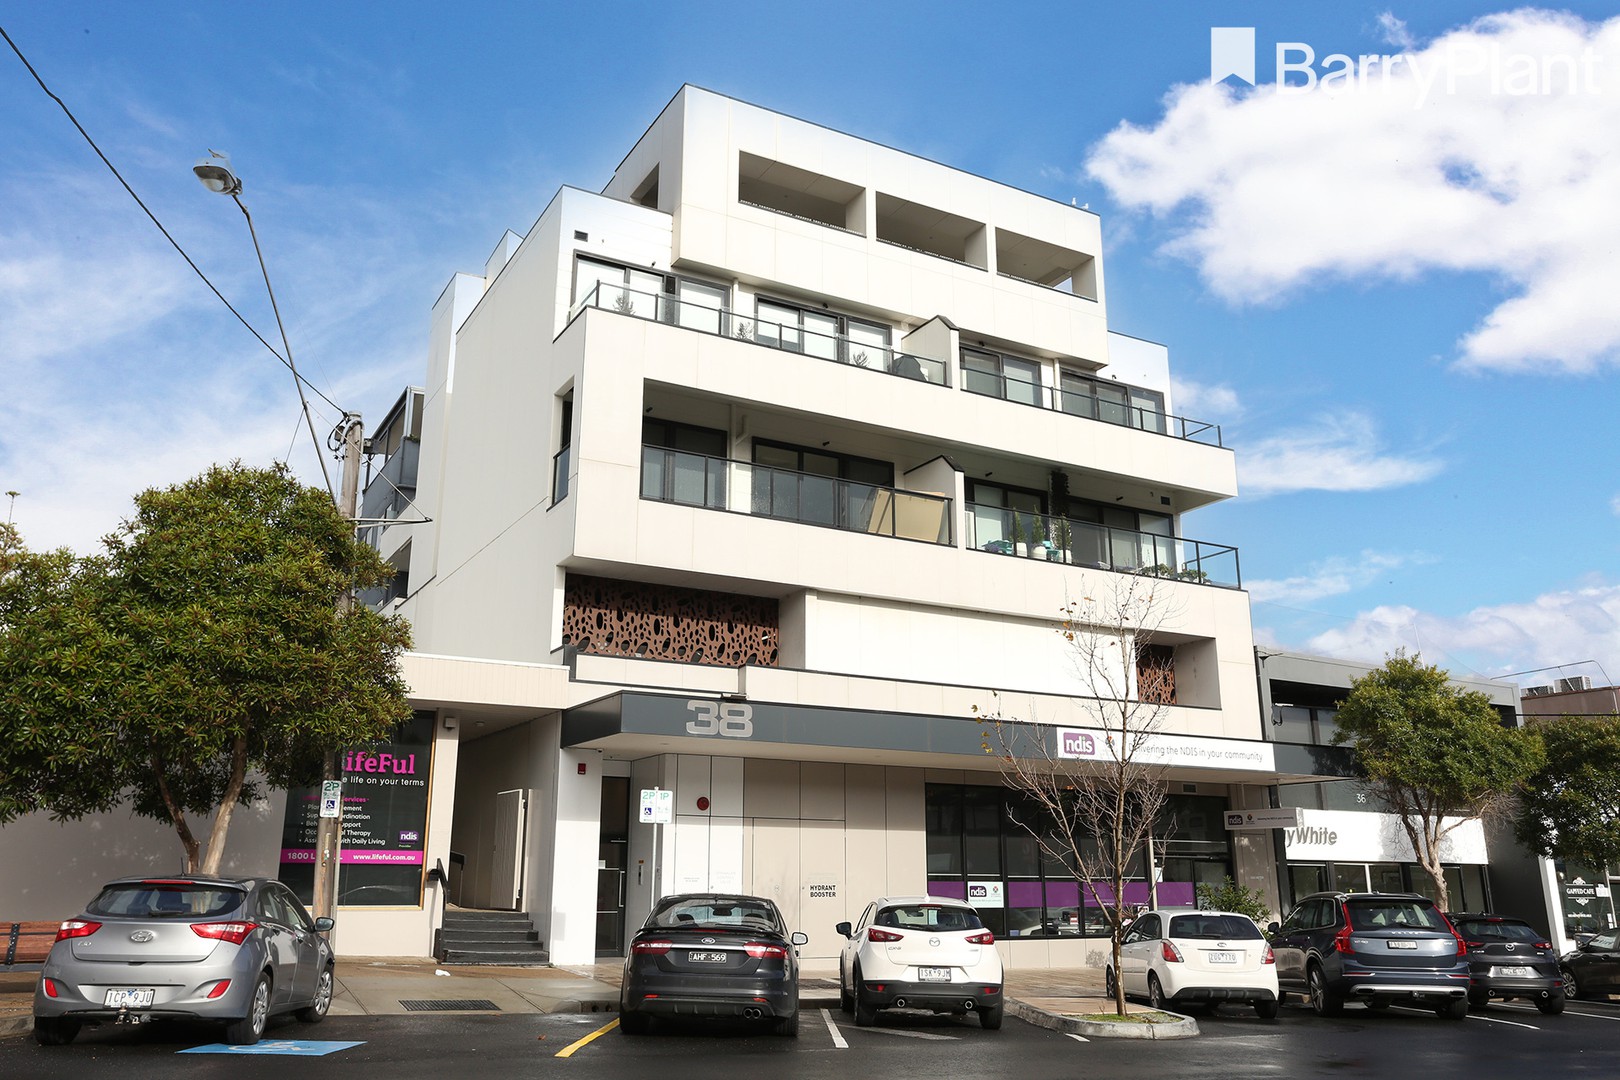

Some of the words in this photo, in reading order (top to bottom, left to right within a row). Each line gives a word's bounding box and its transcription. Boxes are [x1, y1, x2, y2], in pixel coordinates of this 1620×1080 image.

[686, 700, 753, 737] 38
[1066, 736, 1093, 752] ndis
[1129, 743, 1165, 756] Dlivering
[1167, 745, 1178, 755] the
[1180, 747, 1198, 756] NDIS
[1207, 750, 1223, 760] your
[1225, 750, 1263, 762] community
[345, 751, 415, 774] ifeFul
[351, 776, 363, 784] life
[380, 778, 399, 787] your
[401, 779, 425, 787] terms
[324, 782, 340, 791] 2P
[642, 791, 655, 800] 2P
[660, 792, 670, 800] 1P
[1229, 816, 1242, 824] ndis
[347, 829, 371, 837] Therapy
[400, 831, 417, 840] ndis
[1285, 826, 1338, 848] yWhite
[288, 852, 309, 860] 1800
[353, 853, 416, 861] www.lifeful.com.au
[970, 887, 986, 896] ndis
[109, 992, 127, 1003] 1CP
[133, 992, 152, 1003] 9JU
